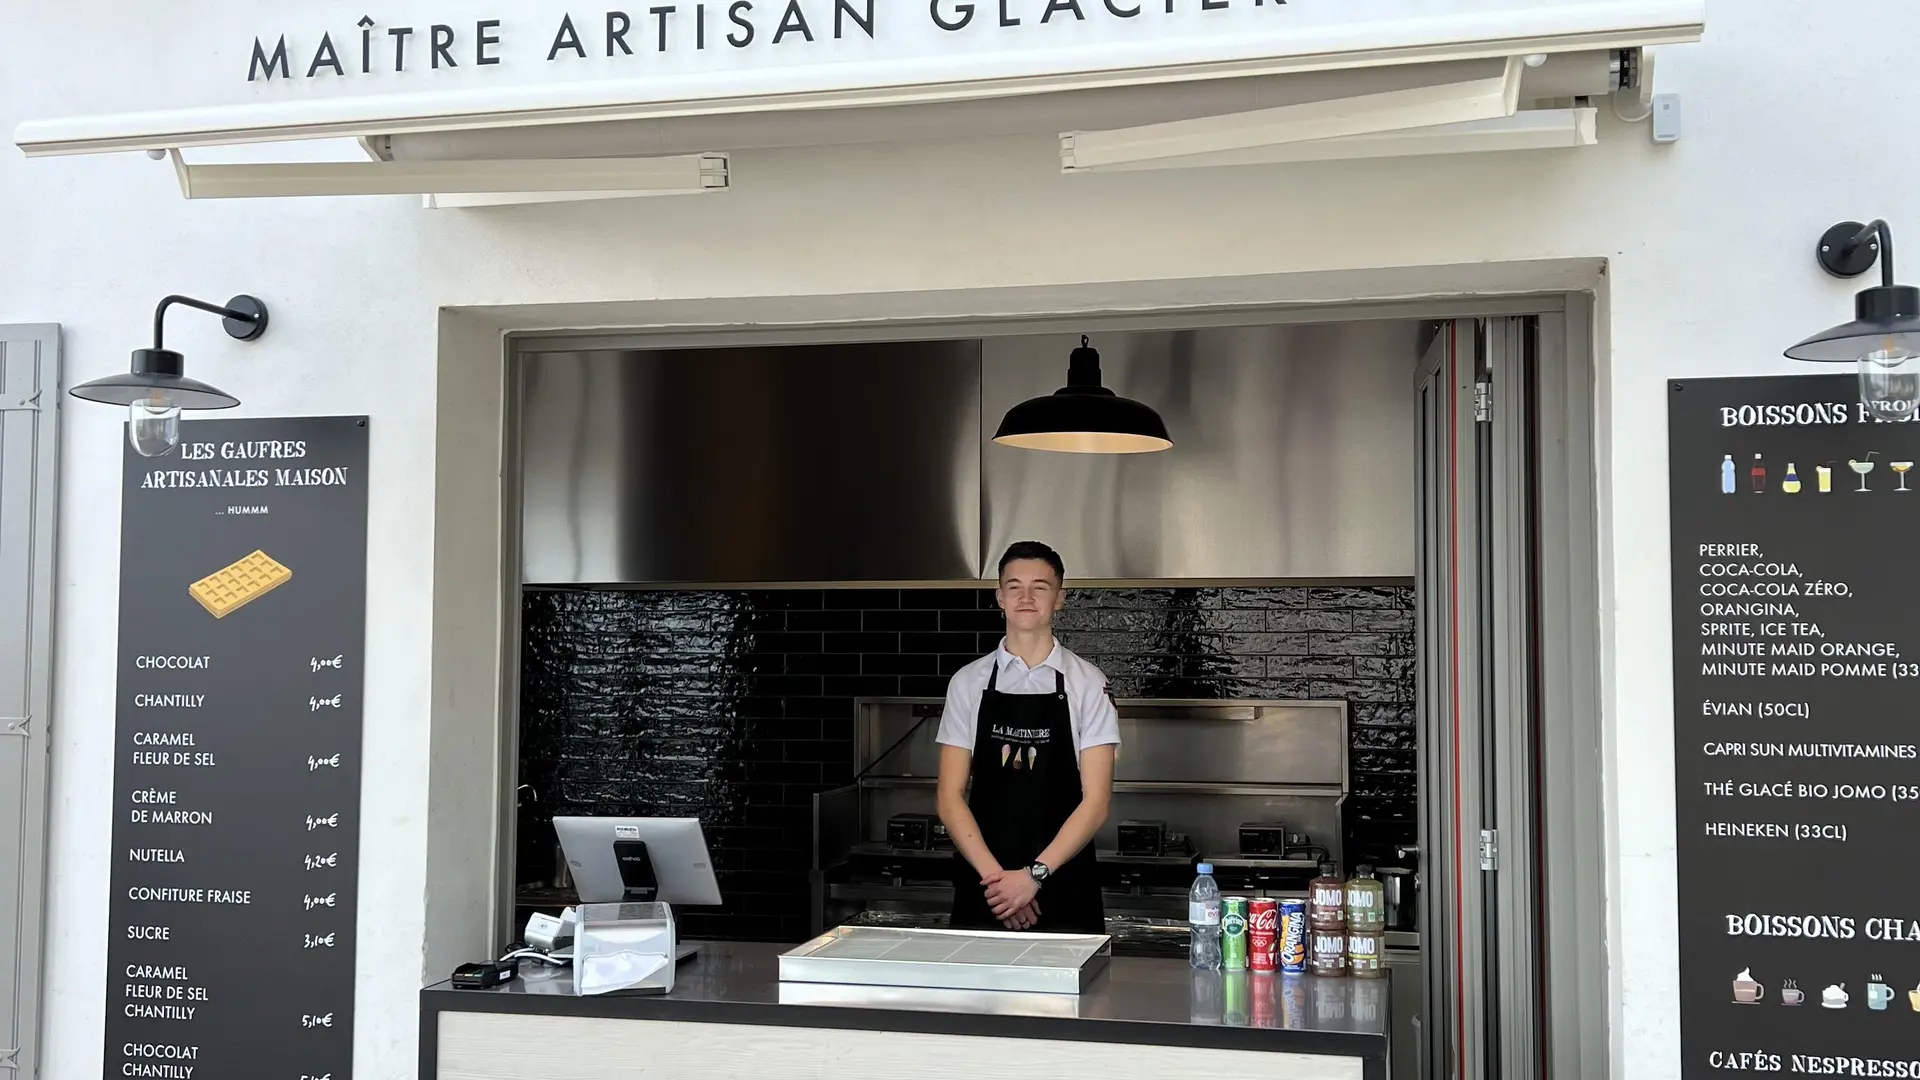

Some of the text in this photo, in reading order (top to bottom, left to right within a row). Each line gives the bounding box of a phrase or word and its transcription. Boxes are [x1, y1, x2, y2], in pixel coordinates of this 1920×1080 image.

[248, 15, 500, 82] MAÎTRE
[546, 0, 875, 60] ARTISAN
[1720, 403, 1847, 426] BOISSONS
[181, 441, 305, 460] LES GAUFRES
[141, 467, 347, 488] ARTISANALES MAISON
[228, 506, 268, 514] HUMMM
[1700, 544, 1763, 558] PERRIER,
[1700, 564, 1802, 577] COCA-COLA,
[1700, 580, 1852, 597] COCA-COLA ZÉRO,
[1701, 603, 1799, 617] ORANGINA,
[1702, 623, 1824, 637] SPRITE, ICE TEA,
[1702, 643, 1899, 658] MINUTE MAID ORANGE,
[136, 656, 210, 668] CHOCOLAT
[1703, 663, 1765, 675] MINUTE
[1772, 663, 1815, 675] MAID
[1822, 663, 1886, 676] POMME
[135, 694, 204, 707] CHANTILLY
[1703, 700, 1809, 718] ÉVIAN (50CL)
[134, 733, 195, 745] CARAMEL
[1704, 743, 1916, 758] CAPRI SUN MULTIVITAMINES
[134, 752, 215, 765] FLEUR DE SEL
[132, 788, 176, 803] CRÈME
[1704, 780, 1733, 795] THÉ
[1739, 781, 1792, 796] GLACÉ
[1799, 784, 1827, 797] BIO
[1832, 785, 1885, 798] JOMO
[132, 810, 212, 824] DE MARRON
[1706, 823, 1846, 841] HEINEKEN (33CL)
[130, 849, 184, 862] NUTELLA
[129, 887, 250, 903] CONFITURE FRAISE
[1313, 889, 1342, 906] JOMO
[128, 926, 169, 939] SUCRE
[1726, 914, 1855, 938] BOISSONS
[1281, 912, 1304, 963] ORANGINA
[1314, 936, 1343, 953] JOMO
[126, 965, 188, 979] CARAMEL
[126, 984, 208, 1000] FLEUR DE SEL
[125, 1004, 195, 1019] CHANTILLY
[124, 1043, 198, 1059] CHOCOLAT
[1710, 1050, 1781, 1071] CAFÉS
[123, 1063, 193, 1079] CHANTILLY
